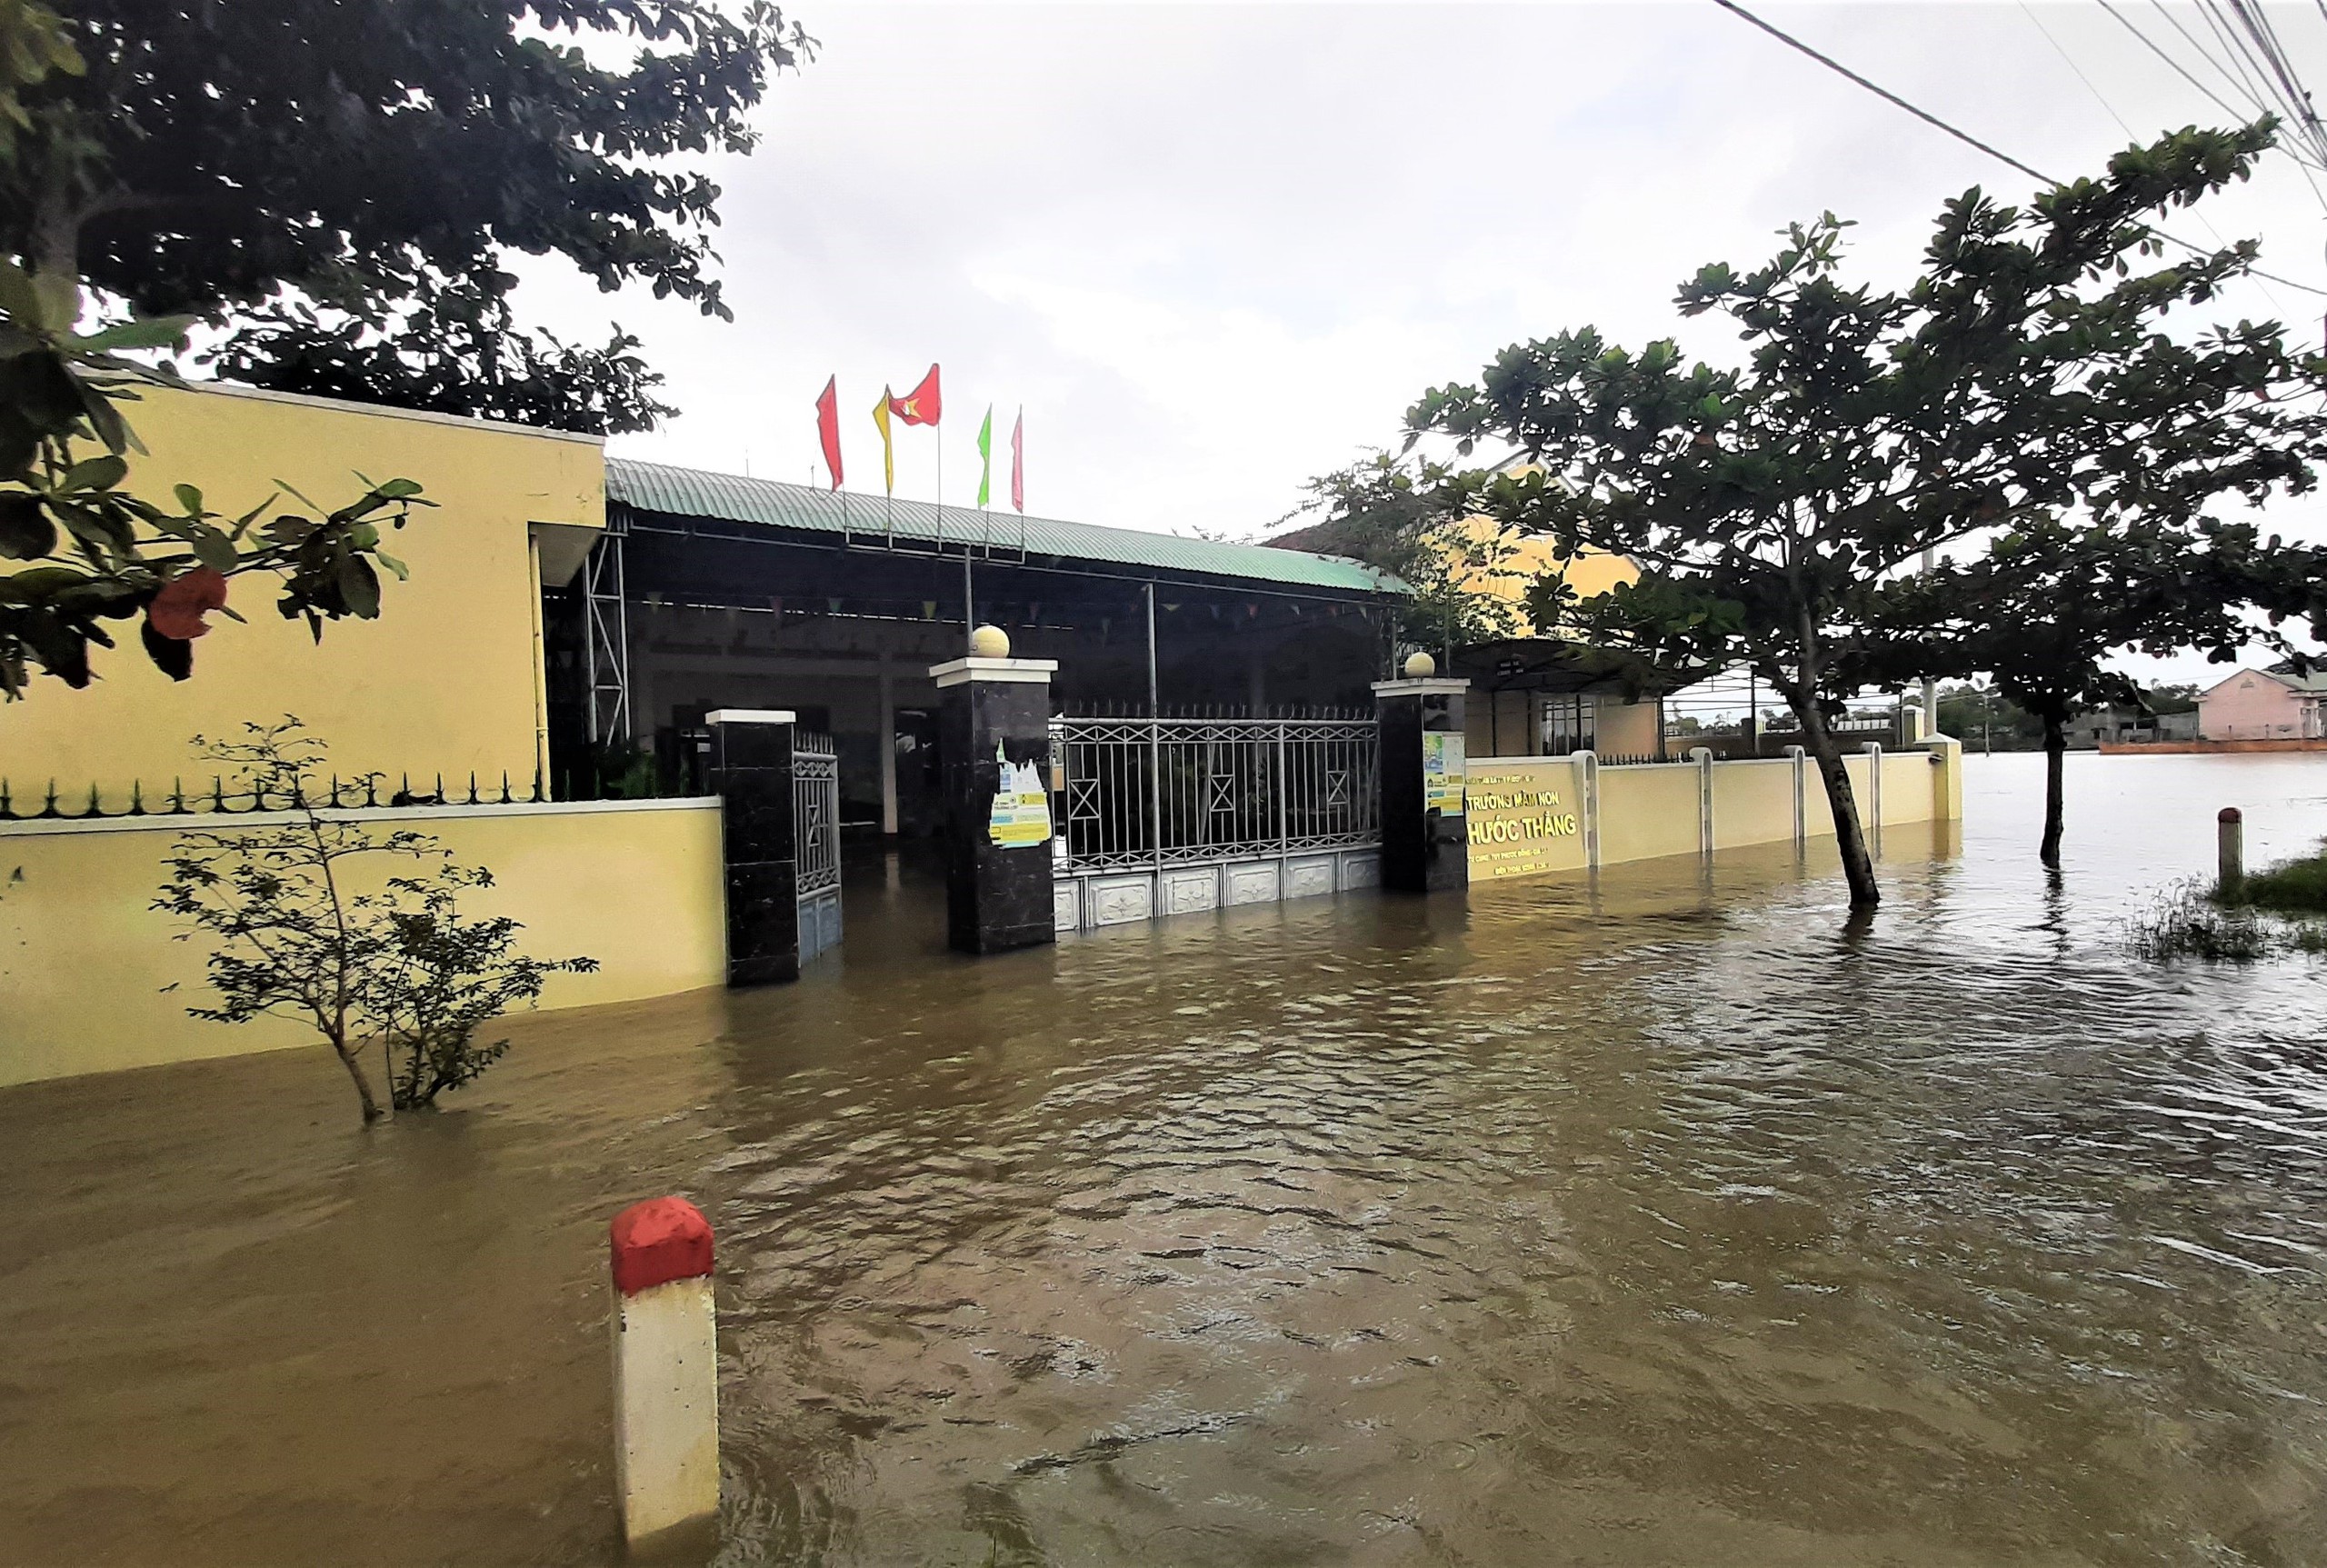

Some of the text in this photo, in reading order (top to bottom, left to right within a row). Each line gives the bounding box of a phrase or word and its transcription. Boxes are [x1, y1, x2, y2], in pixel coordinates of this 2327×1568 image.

[1538, 791, 1560, 806] NON
[1466, 811, 1577, 845] HƯỚC THẮNG
